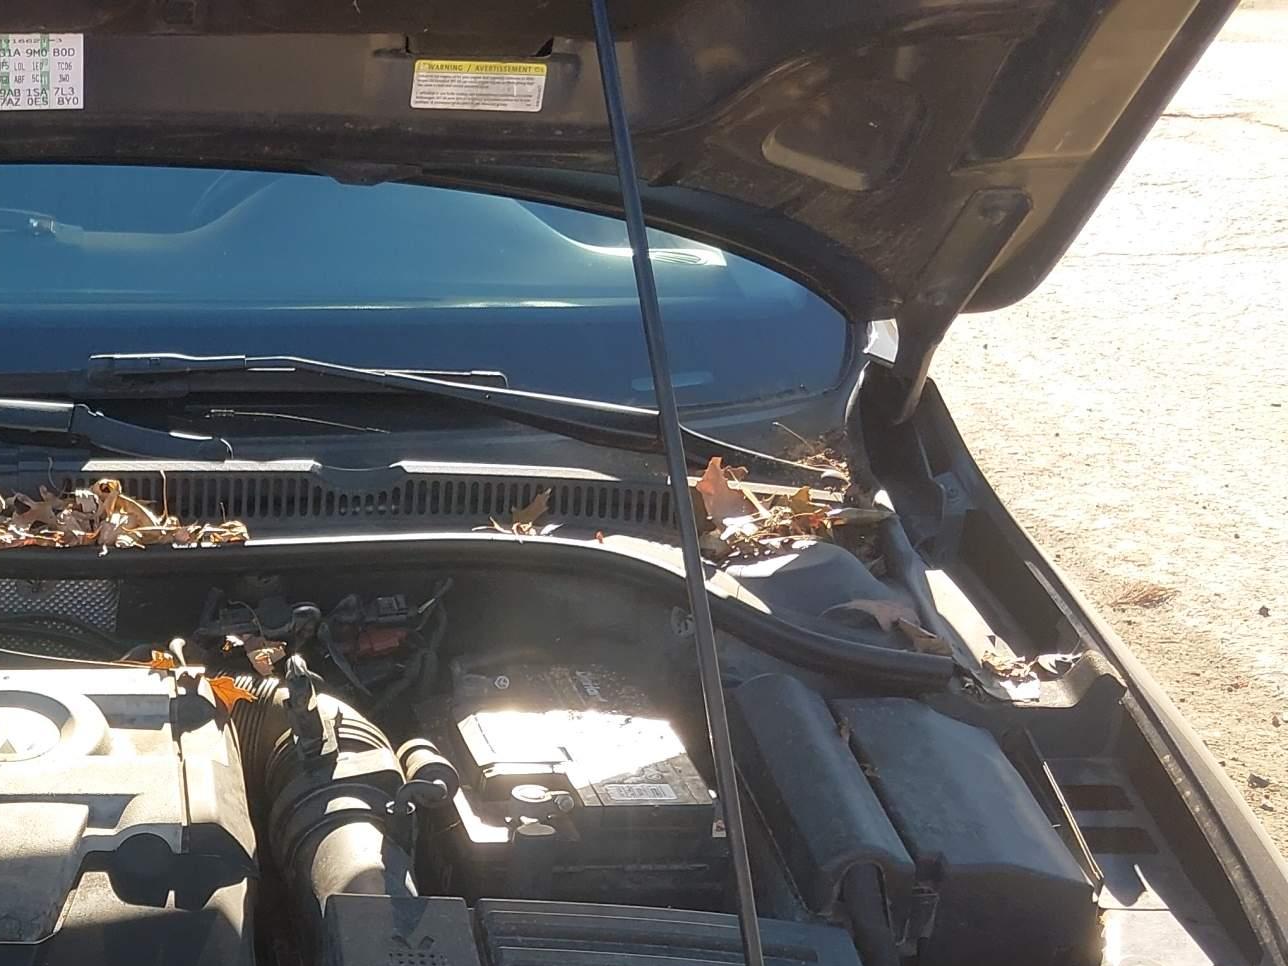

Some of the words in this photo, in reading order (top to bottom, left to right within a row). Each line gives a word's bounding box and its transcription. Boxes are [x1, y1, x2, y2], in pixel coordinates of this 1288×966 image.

[428, 63, 463, 71] WARNING
[475, 64, 531, 73] AVERTISSEMENT
[54, 87, 74, 96] 7L3
